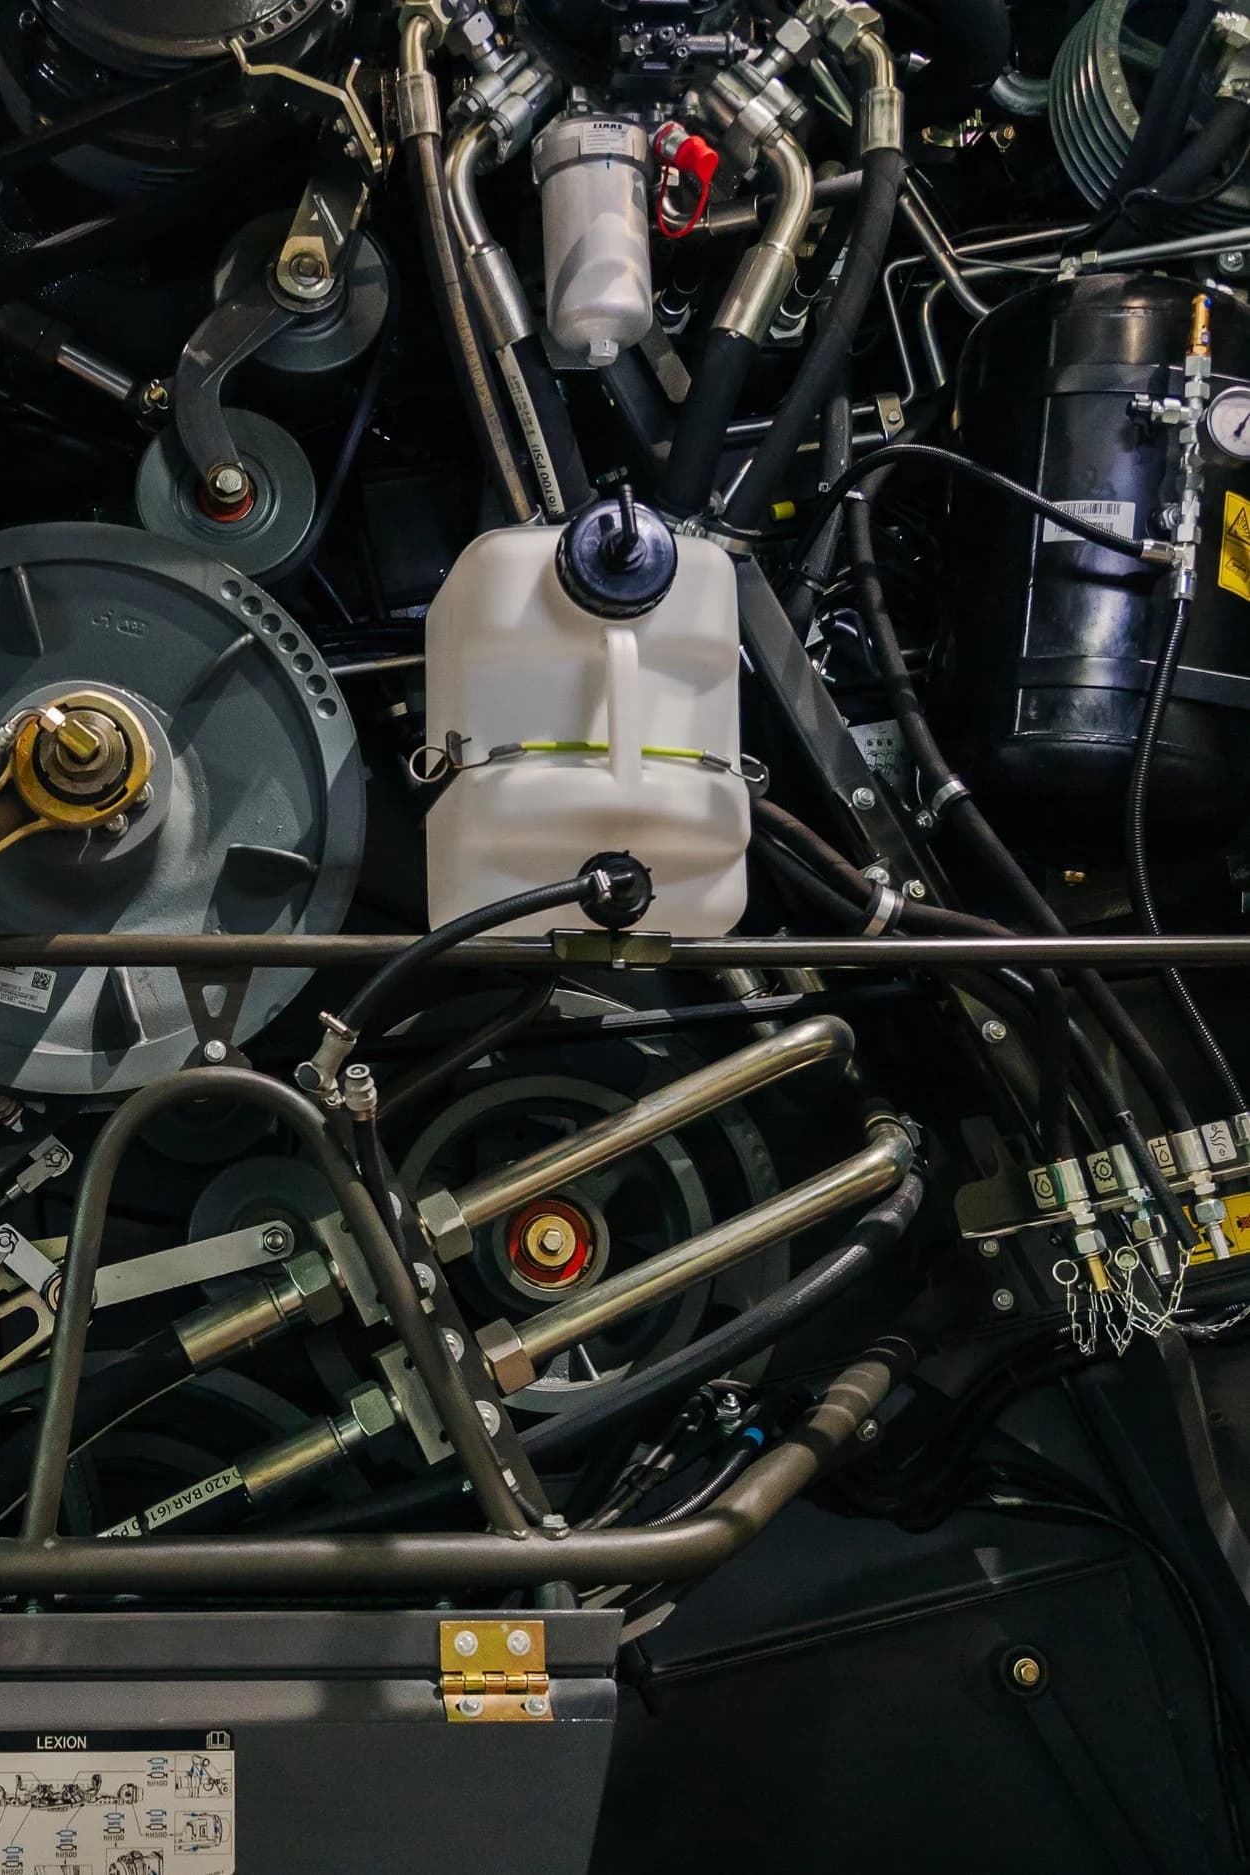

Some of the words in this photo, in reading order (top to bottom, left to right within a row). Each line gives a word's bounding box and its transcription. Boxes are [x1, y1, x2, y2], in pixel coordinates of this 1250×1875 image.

[205, 1474, 231, 1494] 420
[174, 1487, 204, 1510] BAR
[131, 1503, 171, 1531] (610
[107, 1524, 130, 1537] PS
[36, 1736, 87, 1750] LEXION
